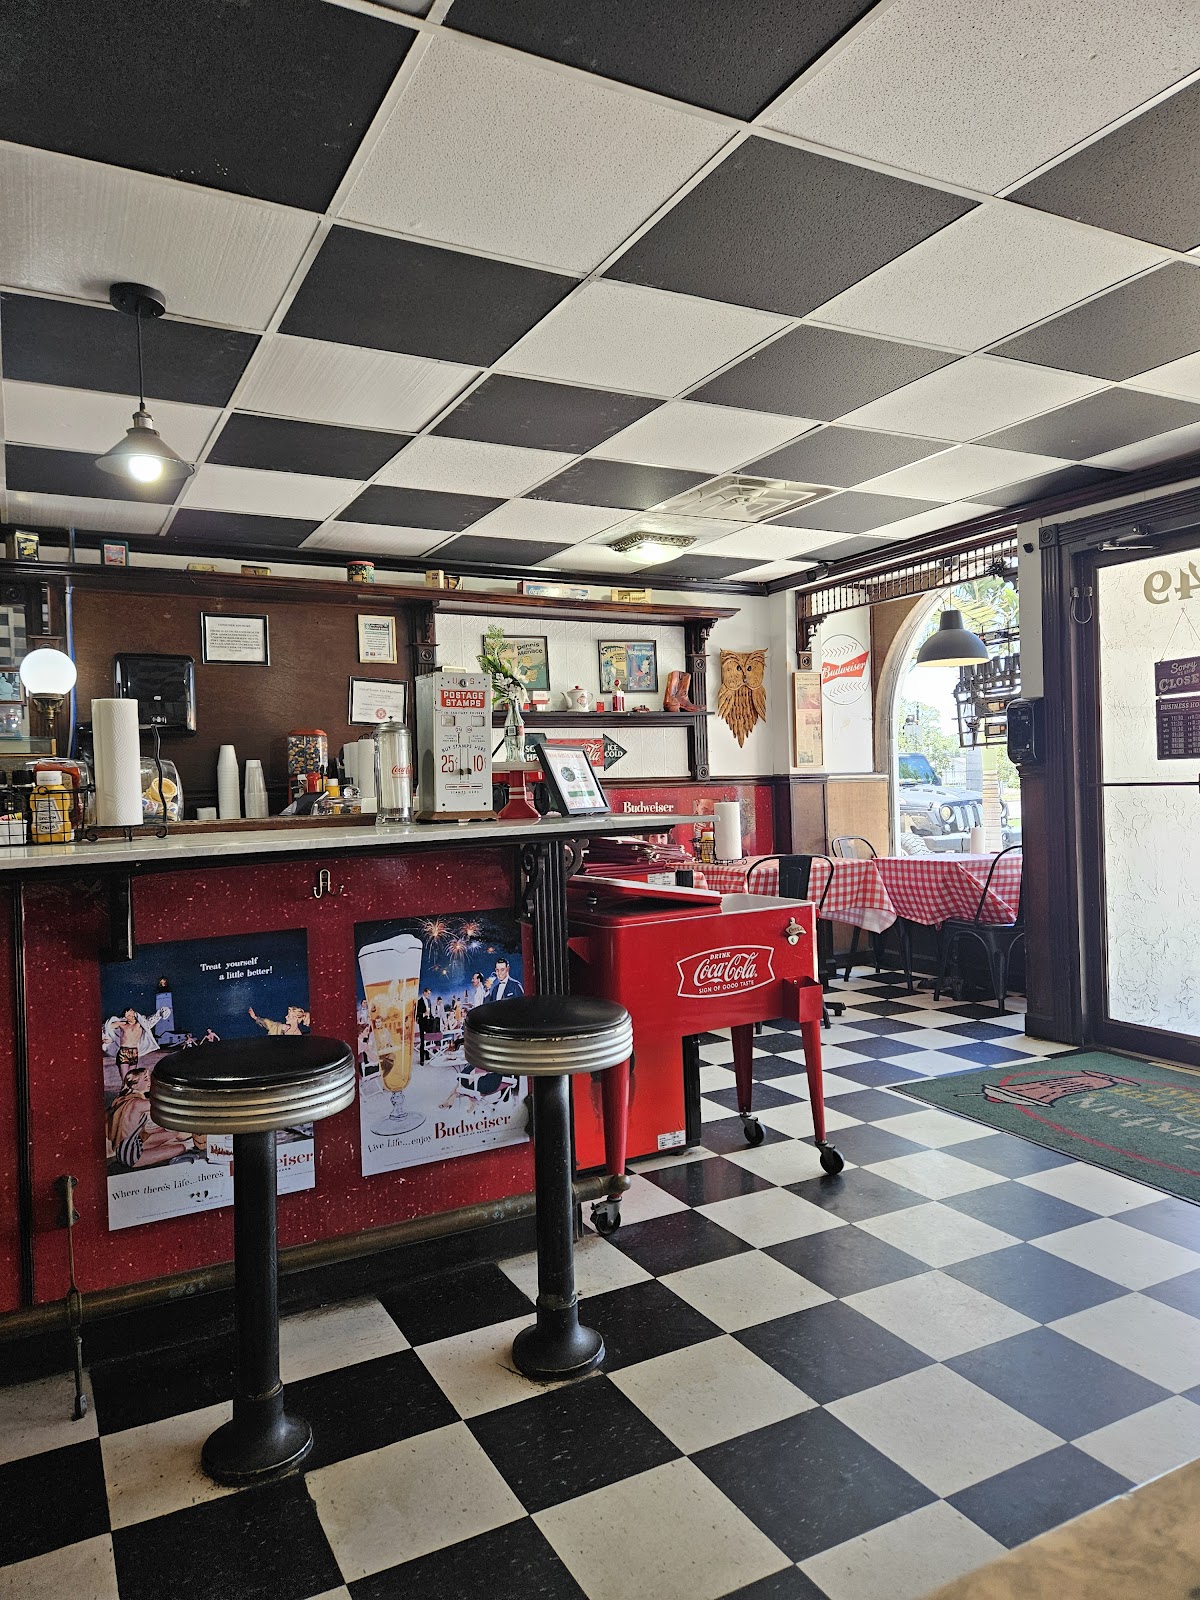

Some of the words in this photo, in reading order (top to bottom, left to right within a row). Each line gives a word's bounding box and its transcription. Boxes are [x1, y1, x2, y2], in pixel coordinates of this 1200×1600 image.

[517, 642, 540, 651] Dennis
[517, 648, 543, 656] Menace
[821, 661, 867, 679] Budweiser
[1170, 661, 1197, 674] Sorry
[444, 691, 484, 700] POSTAGE
[446, 699, 481, 707] STAMPS
[1160, 702, 1189, 711] BUSINESS
[607, 743, 619, 751] ICE
[604, 750, 625, 758] COLD
[623, 801, 674, 813] Budweiser
[710, 951, 731, 960] DRINK
[200, 962, 221, 972] Treat
[225, 956, 258, 969] yourself
[694, 952, 758, 986] Coca-Cola
[226, 970, 244, 979] little
[247, 966, 273, 977] better!
[699, 986, 712, 994] SIGN
[722, 982, 739, 991] GOOD
[740, 979, 754, 987] TASTE
[367, 1142, 384, 1153] Live
[434, 1115, 511, 1139] Budweiser
[111, 1189, 140, 1201] Where
[144, 1183, 171, 1194] there's
